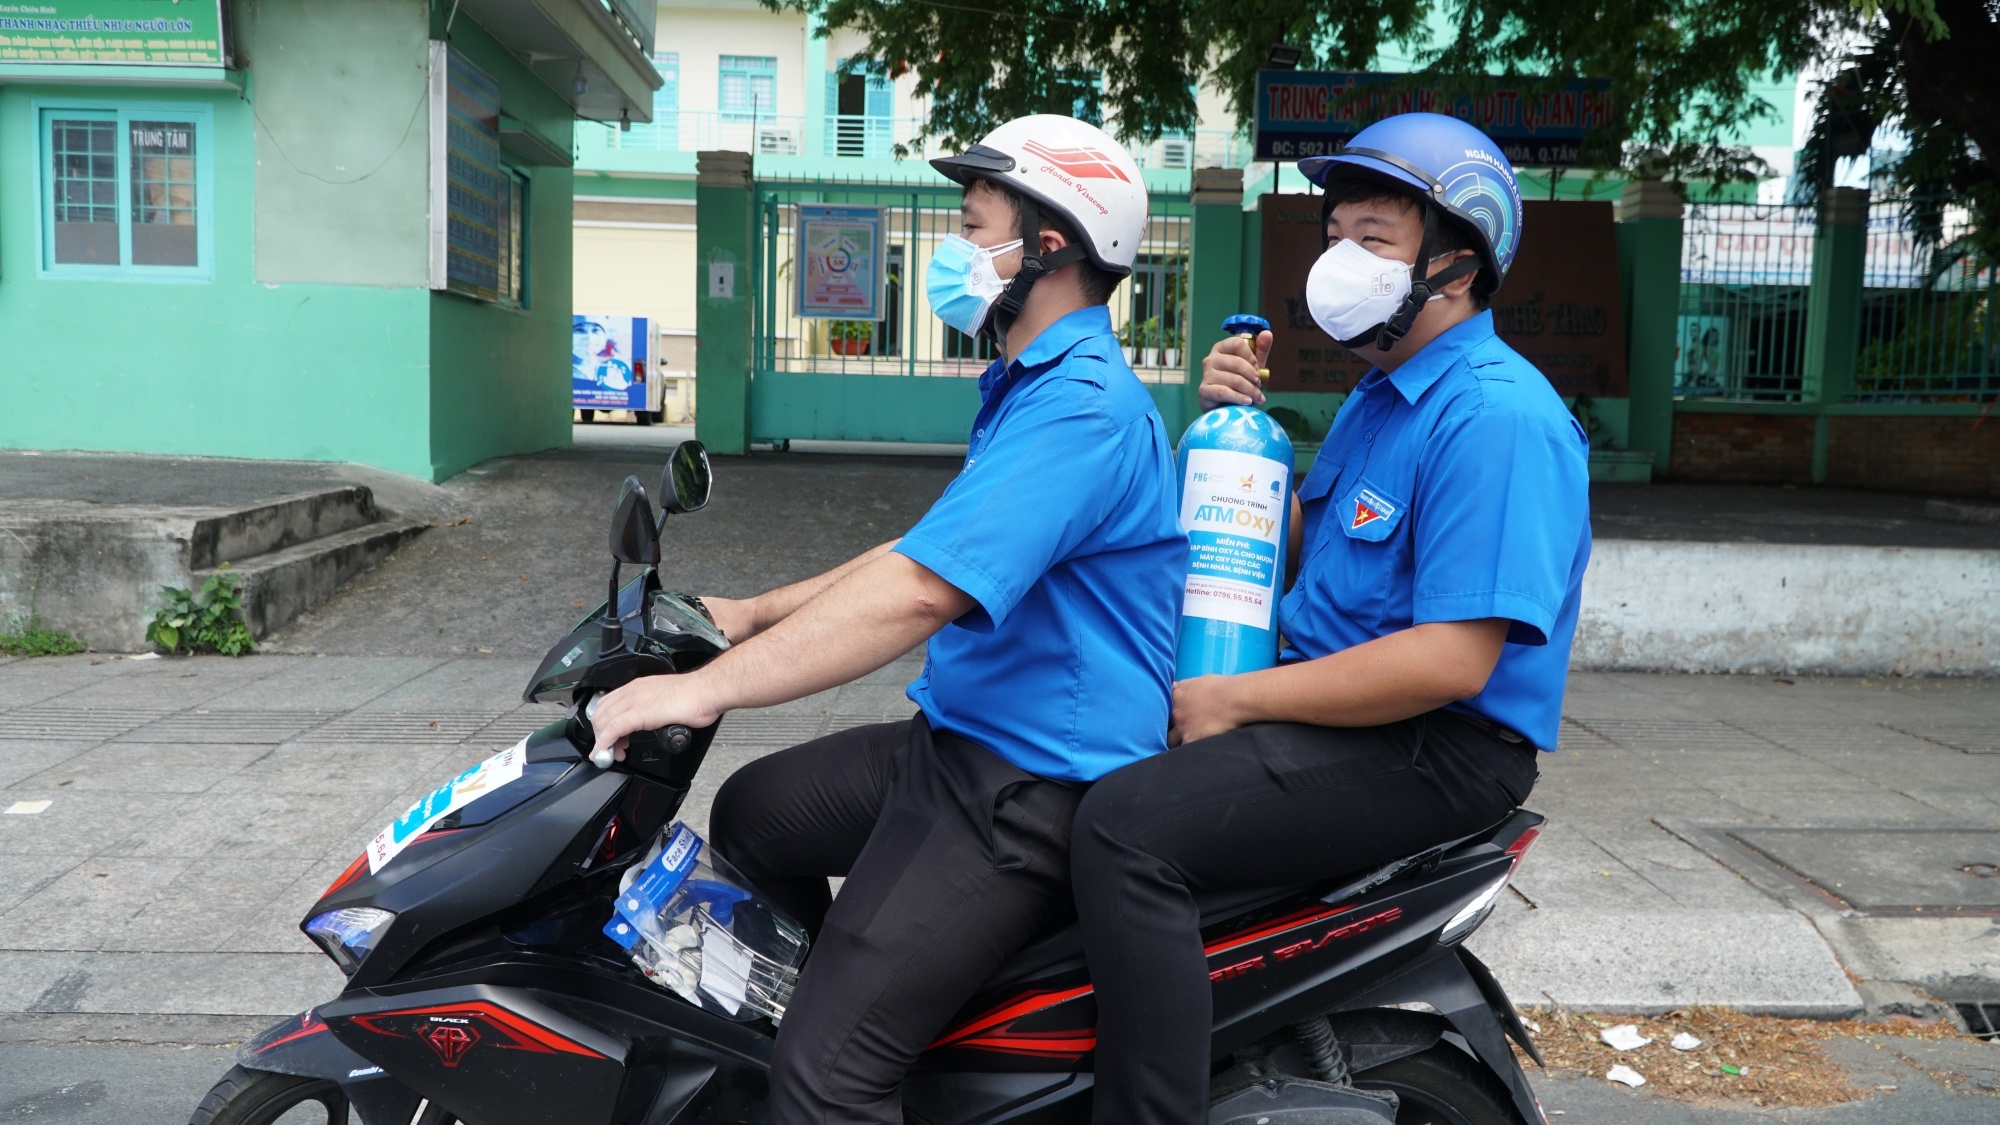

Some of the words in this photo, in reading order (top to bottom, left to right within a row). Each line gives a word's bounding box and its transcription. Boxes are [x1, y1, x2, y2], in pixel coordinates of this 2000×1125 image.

[0, 18, 34, 30] THANH
[37, 19, 66, 33] NHẠC
[103, 20, 122, 31] NHI
[124, 20, 132, 31] &
[1268, 84, 1328, 121] TRUNG
[132, 129, 164, 148] TRUNG
[167, 129, 187, 148] TÂM
[1299, 140, 1324, 155] 502
[1465, 149, 1493, 164] NGÂN
[1493, 158, 1514, 184] HÀNG
[1040, 166, 1073, 187] Honda
[1549, 303, 1606, 335] THAO
[1211, 495, 1245, 506] CHƯƠNG
[1247, 500, 1268, 511] TRÌNH
[1201, 544, 1218, 553] BÌNH
[1219, 547, 1233, 555] OXY
[1241, 551, 1255, 559] CHO
[1199, 553, 1214, 561] MÁY
[1231, 558, 1246, 566] CHO
[1247, 560, 1261, 569] CÁC
[1185, 587, 1212, 597] Hotline:
[666, 847, 683, 867] Face
[678, 829, 693, 850] Shield
[429, 1016, 469, 1024] BLACK
